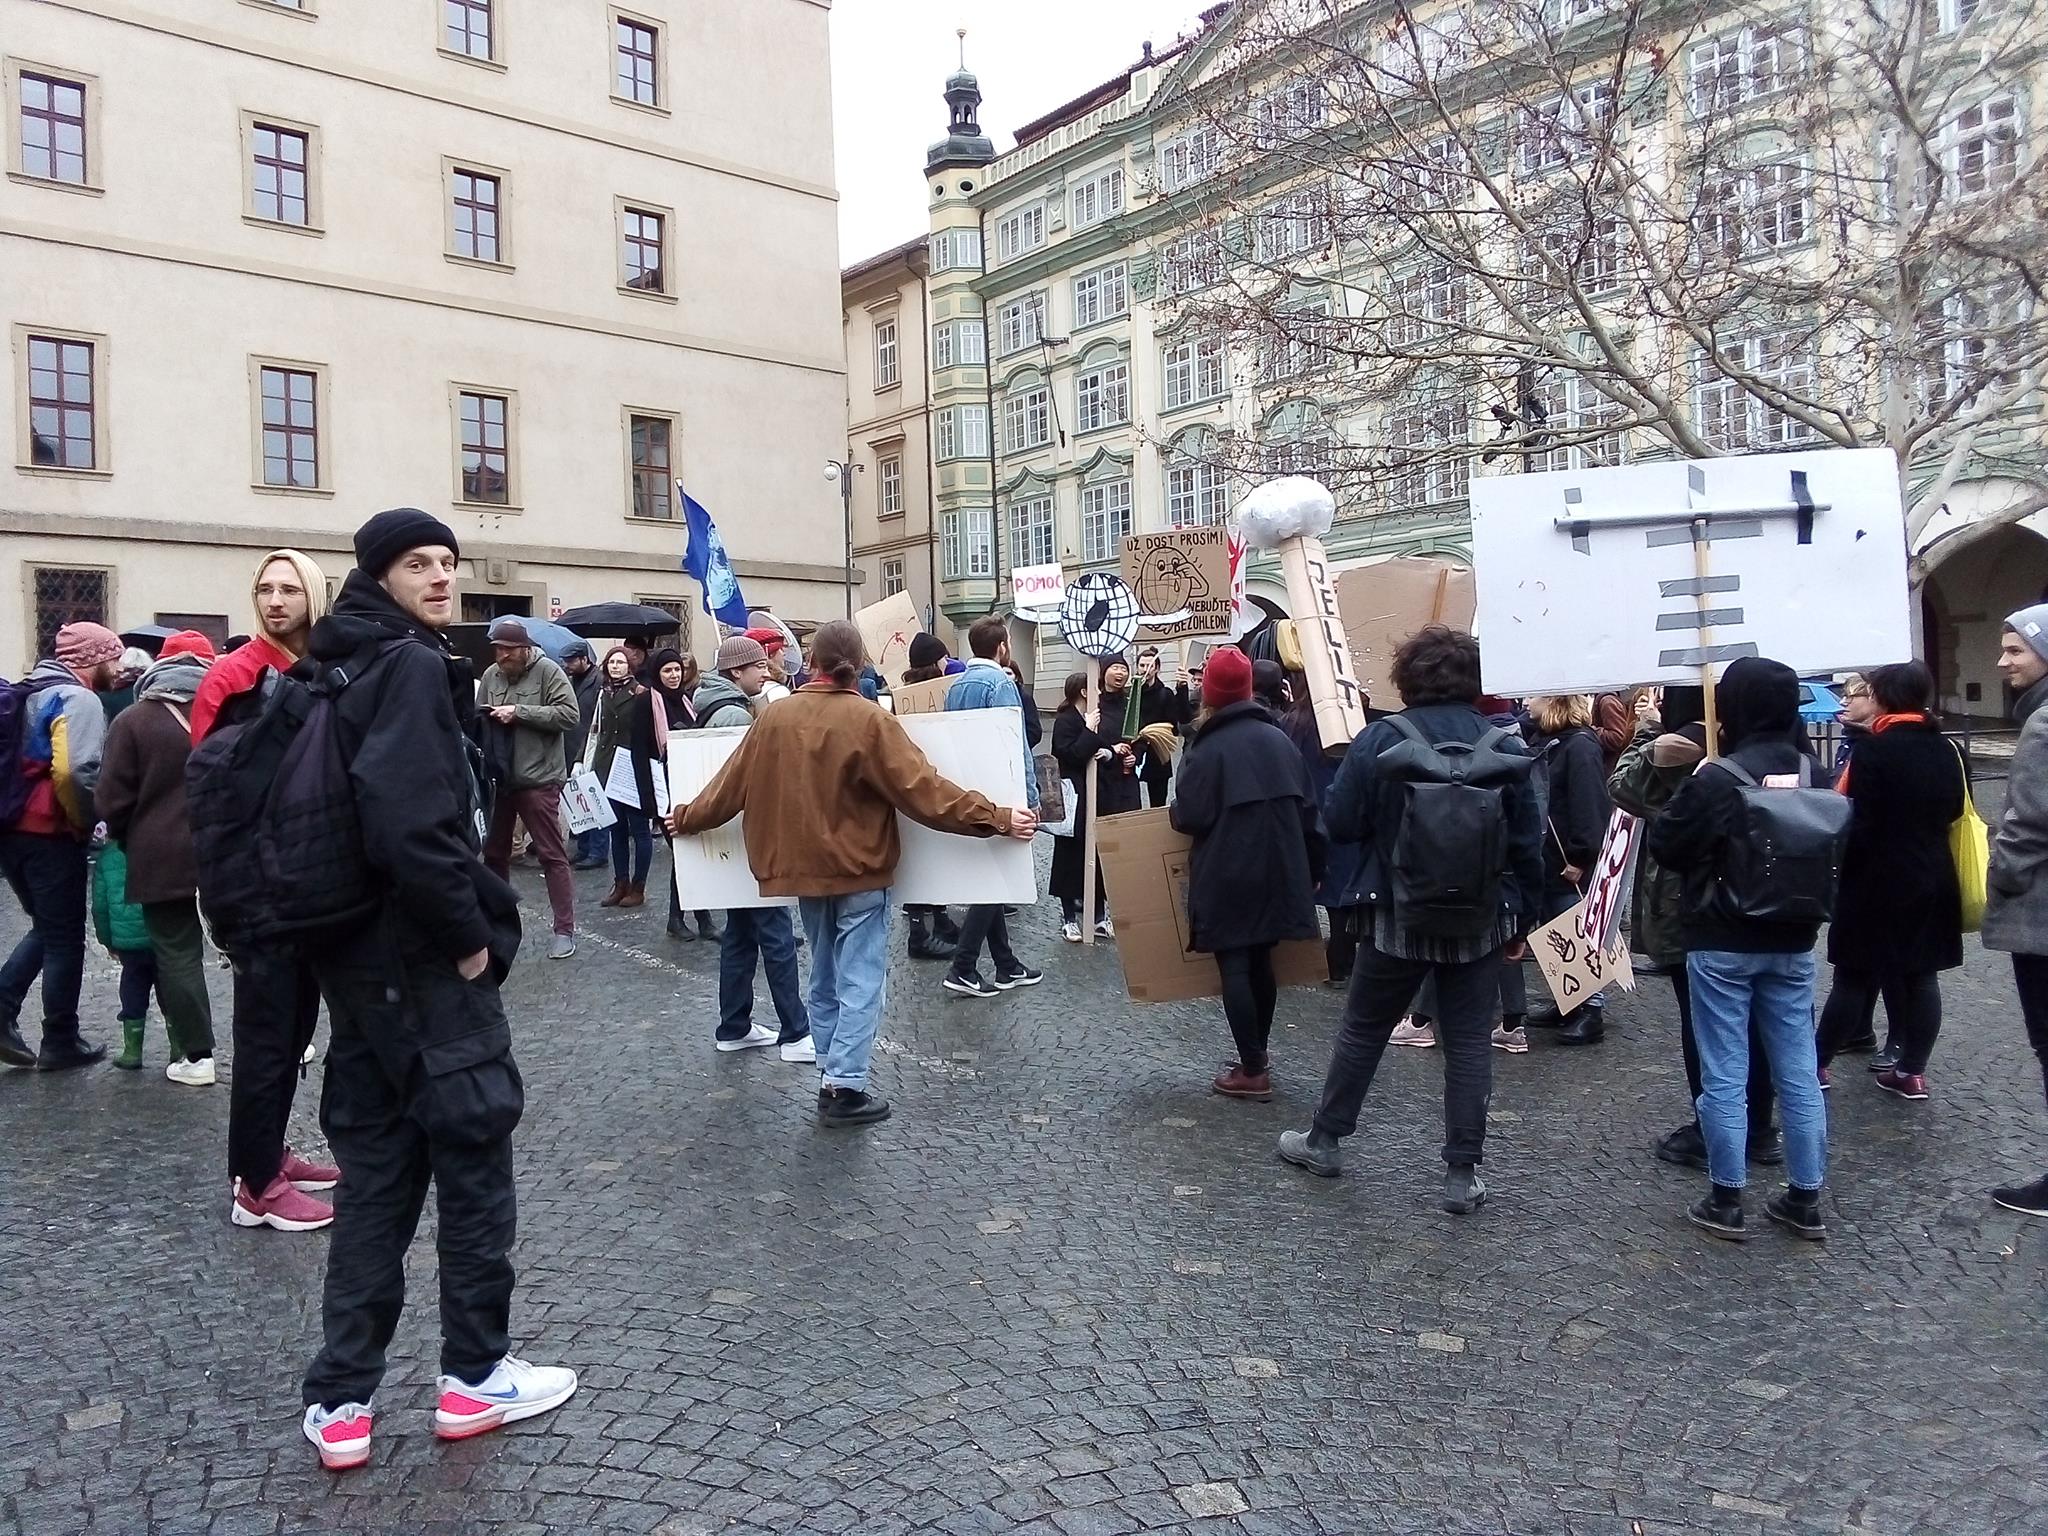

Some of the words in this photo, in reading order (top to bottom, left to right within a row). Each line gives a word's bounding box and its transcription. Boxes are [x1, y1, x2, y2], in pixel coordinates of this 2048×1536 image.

[1127, 537, 1140, 551] UŽ
[1146, 535, 1174, 550] DOST
[1015, 575, 1062, 592] POMOC
